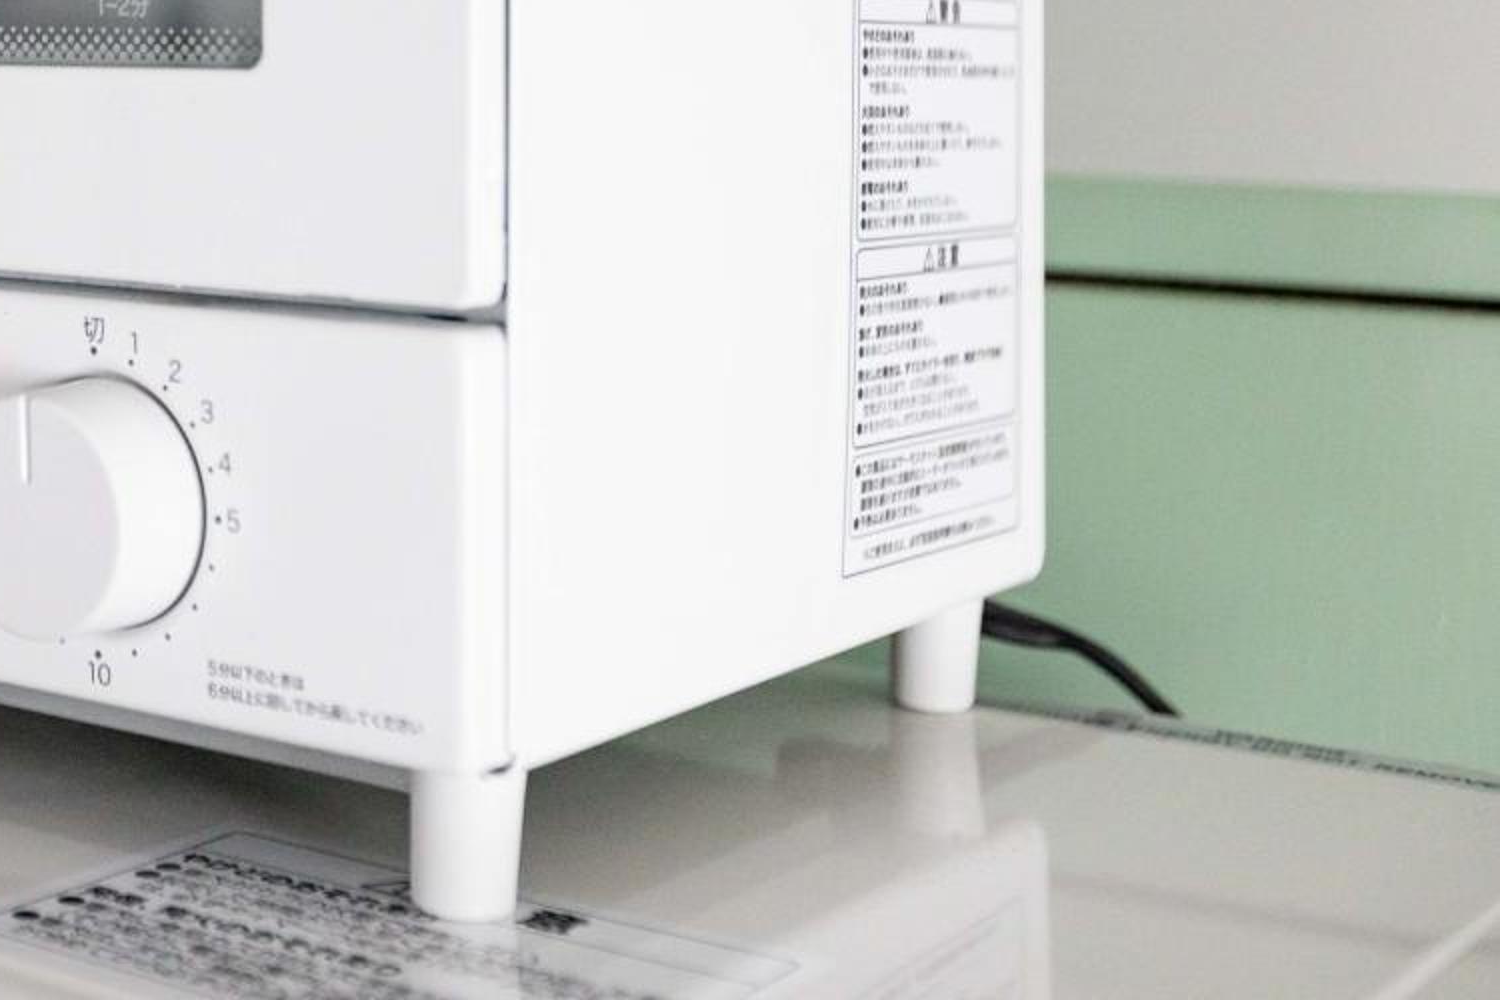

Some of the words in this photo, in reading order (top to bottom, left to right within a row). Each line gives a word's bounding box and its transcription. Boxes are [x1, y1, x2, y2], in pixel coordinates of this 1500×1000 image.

[83, 316, 105, 343] 切
[131, 331, 138, 354] 1
[168, 360, 182, 383] 2
[201, 401, 214, 424] 3
[218, 453, 232, 474] 4
[226, 509, 241, 534] 5
[88, 662, 112, 687] 10
